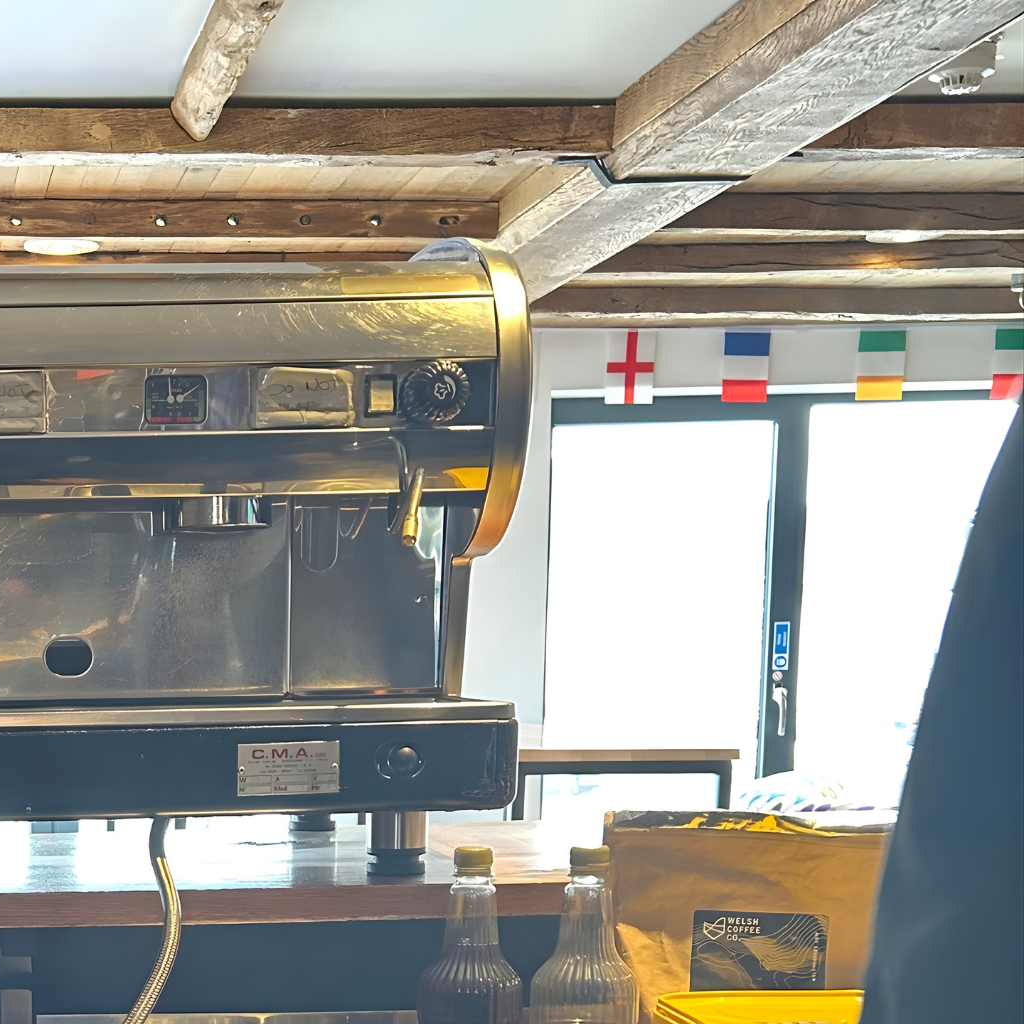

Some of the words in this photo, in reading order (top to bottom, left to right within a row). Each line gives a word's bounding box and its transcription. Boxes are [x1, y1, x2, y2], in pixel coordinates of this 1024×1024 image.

[251, 747, 313, 760] C.M.A.
[727, 916, 759, 926] WELSH
[726, 925, 762, 934] COFFEE
